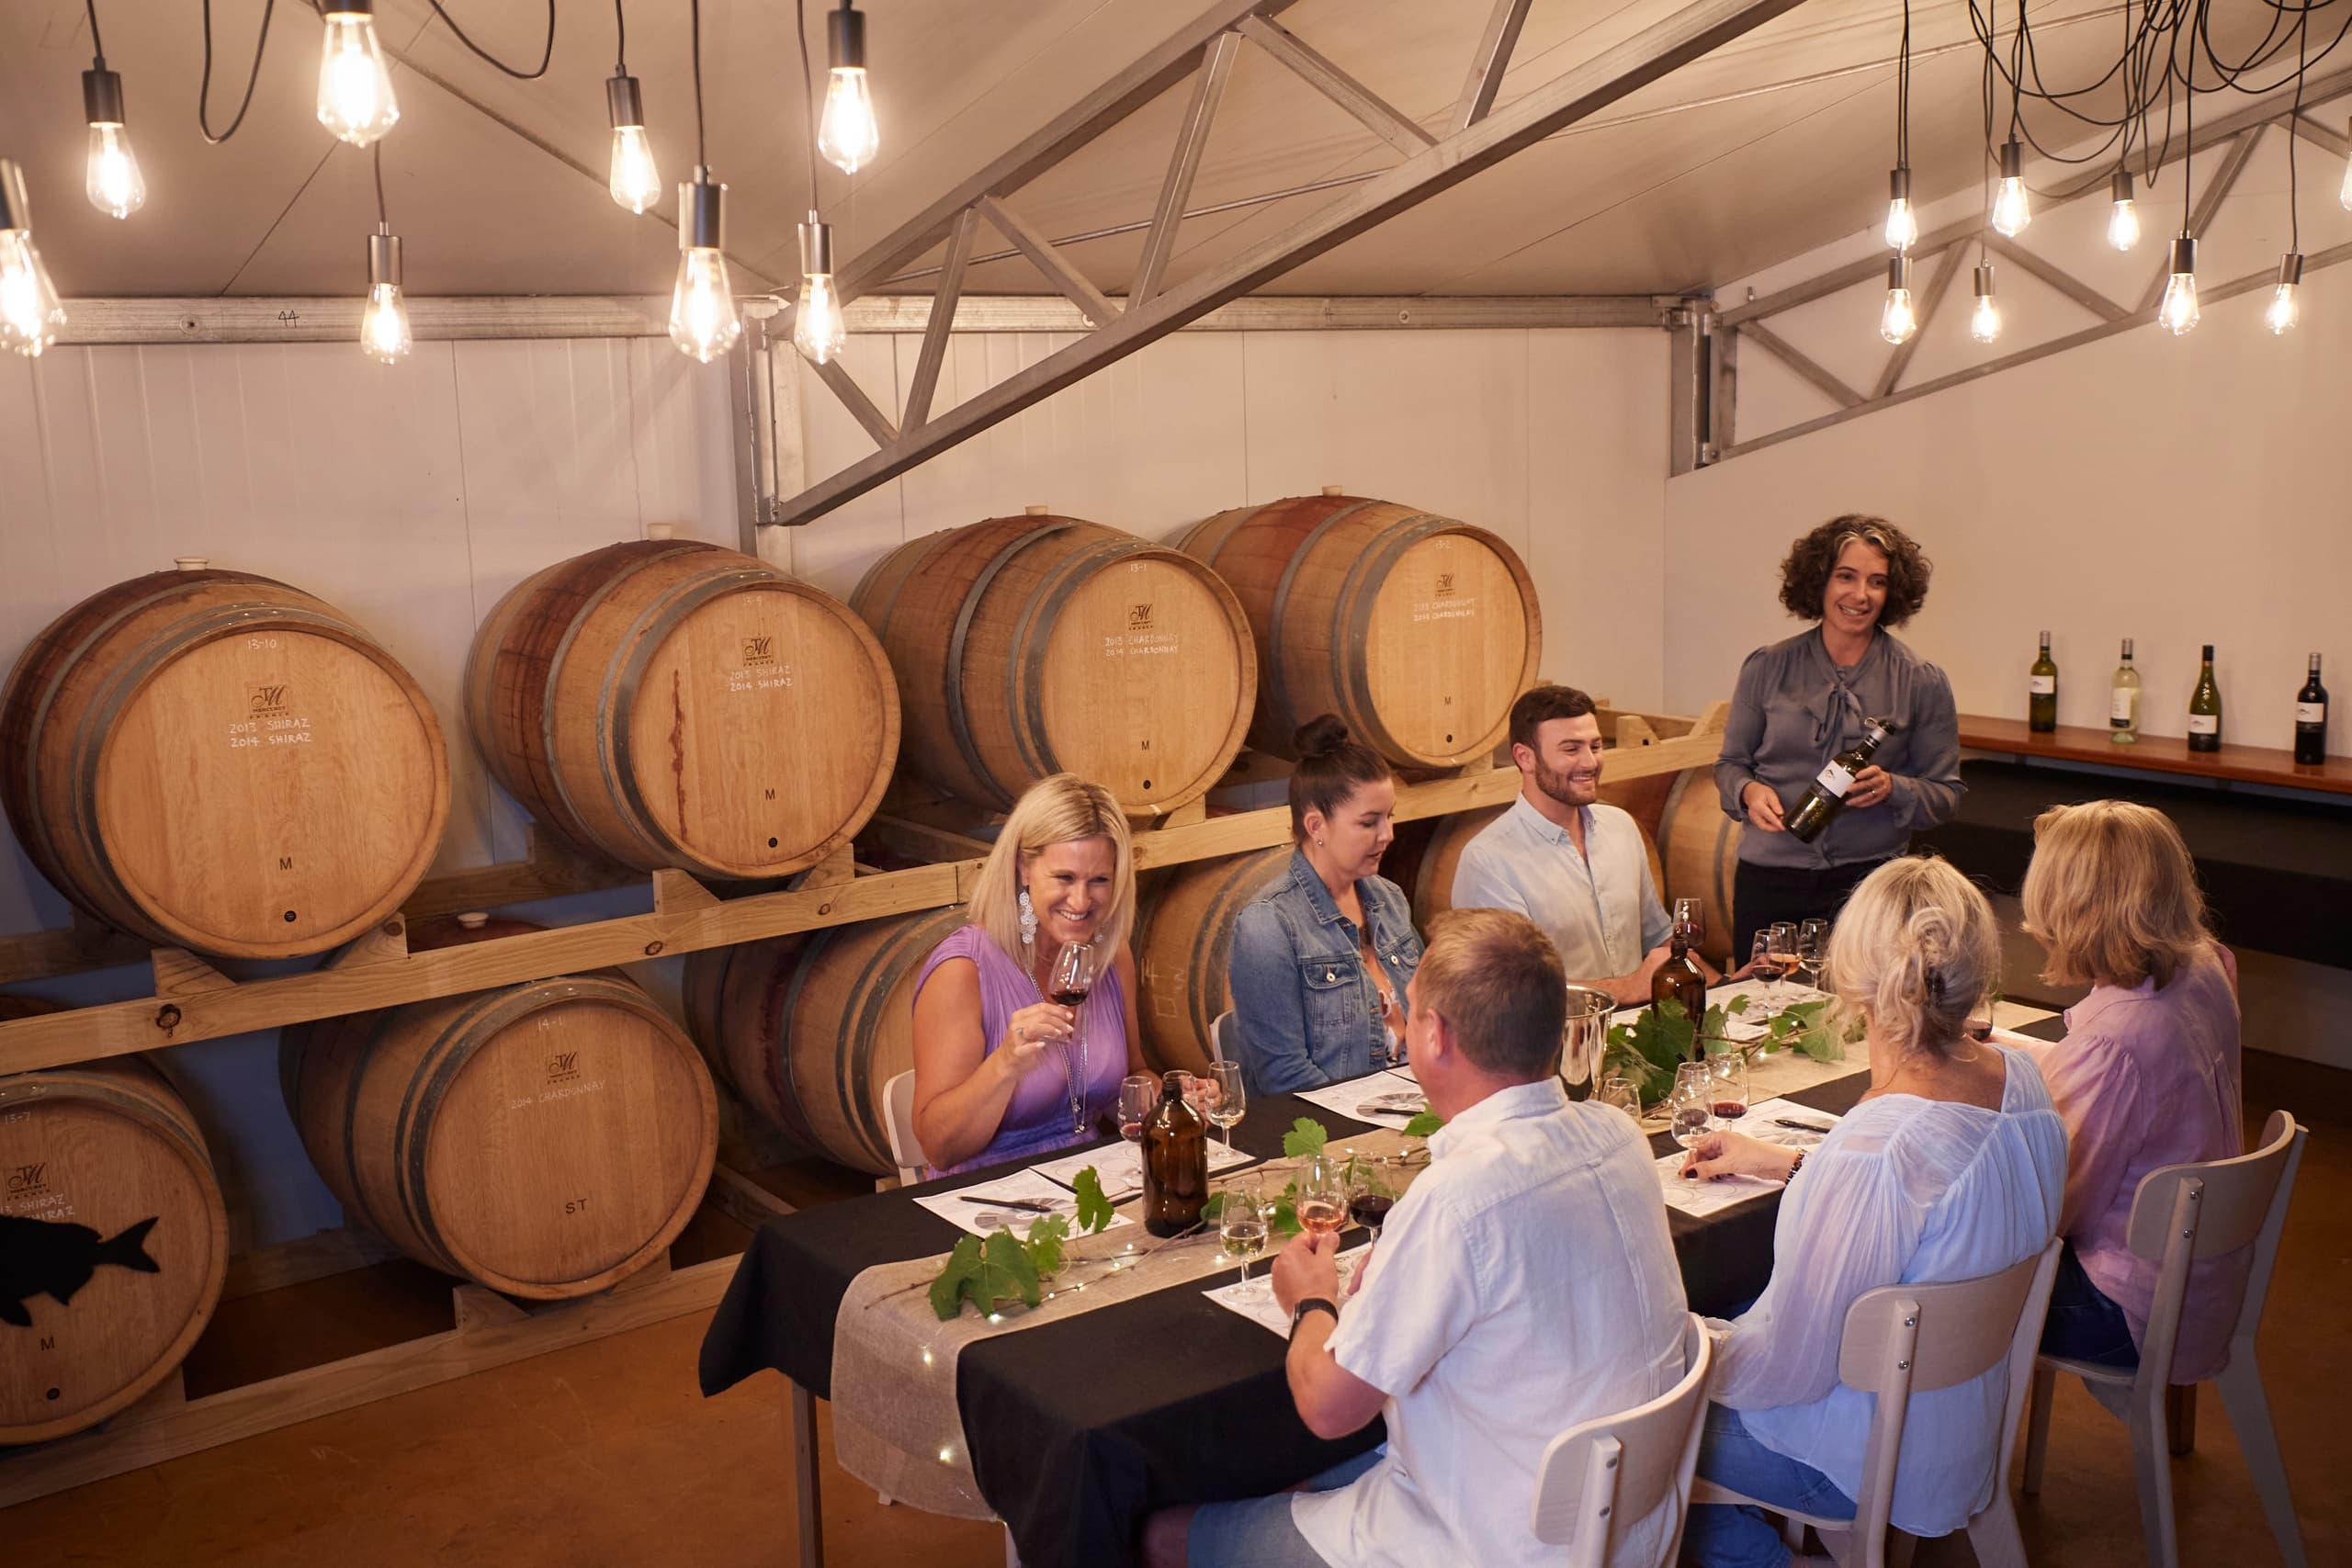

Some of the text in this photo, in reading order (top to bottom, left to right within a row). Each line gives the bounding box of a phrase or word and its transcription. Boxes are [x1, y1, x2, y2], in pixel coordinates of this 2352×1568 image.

[247, 639, 277, 650] 13-10
[756, 664, 791, 677] SHIRAZ
[730, 678, 793, 692] 2014 SHIRAZ
[229, 718, 310, 734] 2013 SHIRAZ
[230, 733, 311, 748] 2014 SHIRAZ
[1141, 740, 1149, 750] M
[765, 788, 775, 800] M
[279, 856, 292, 871] M
[538, 1080, 605, 1102] CHARDONNAY
[19, 1193, 65, 1211] SHIRAZ
[40, 1337, 55, 1351] M
